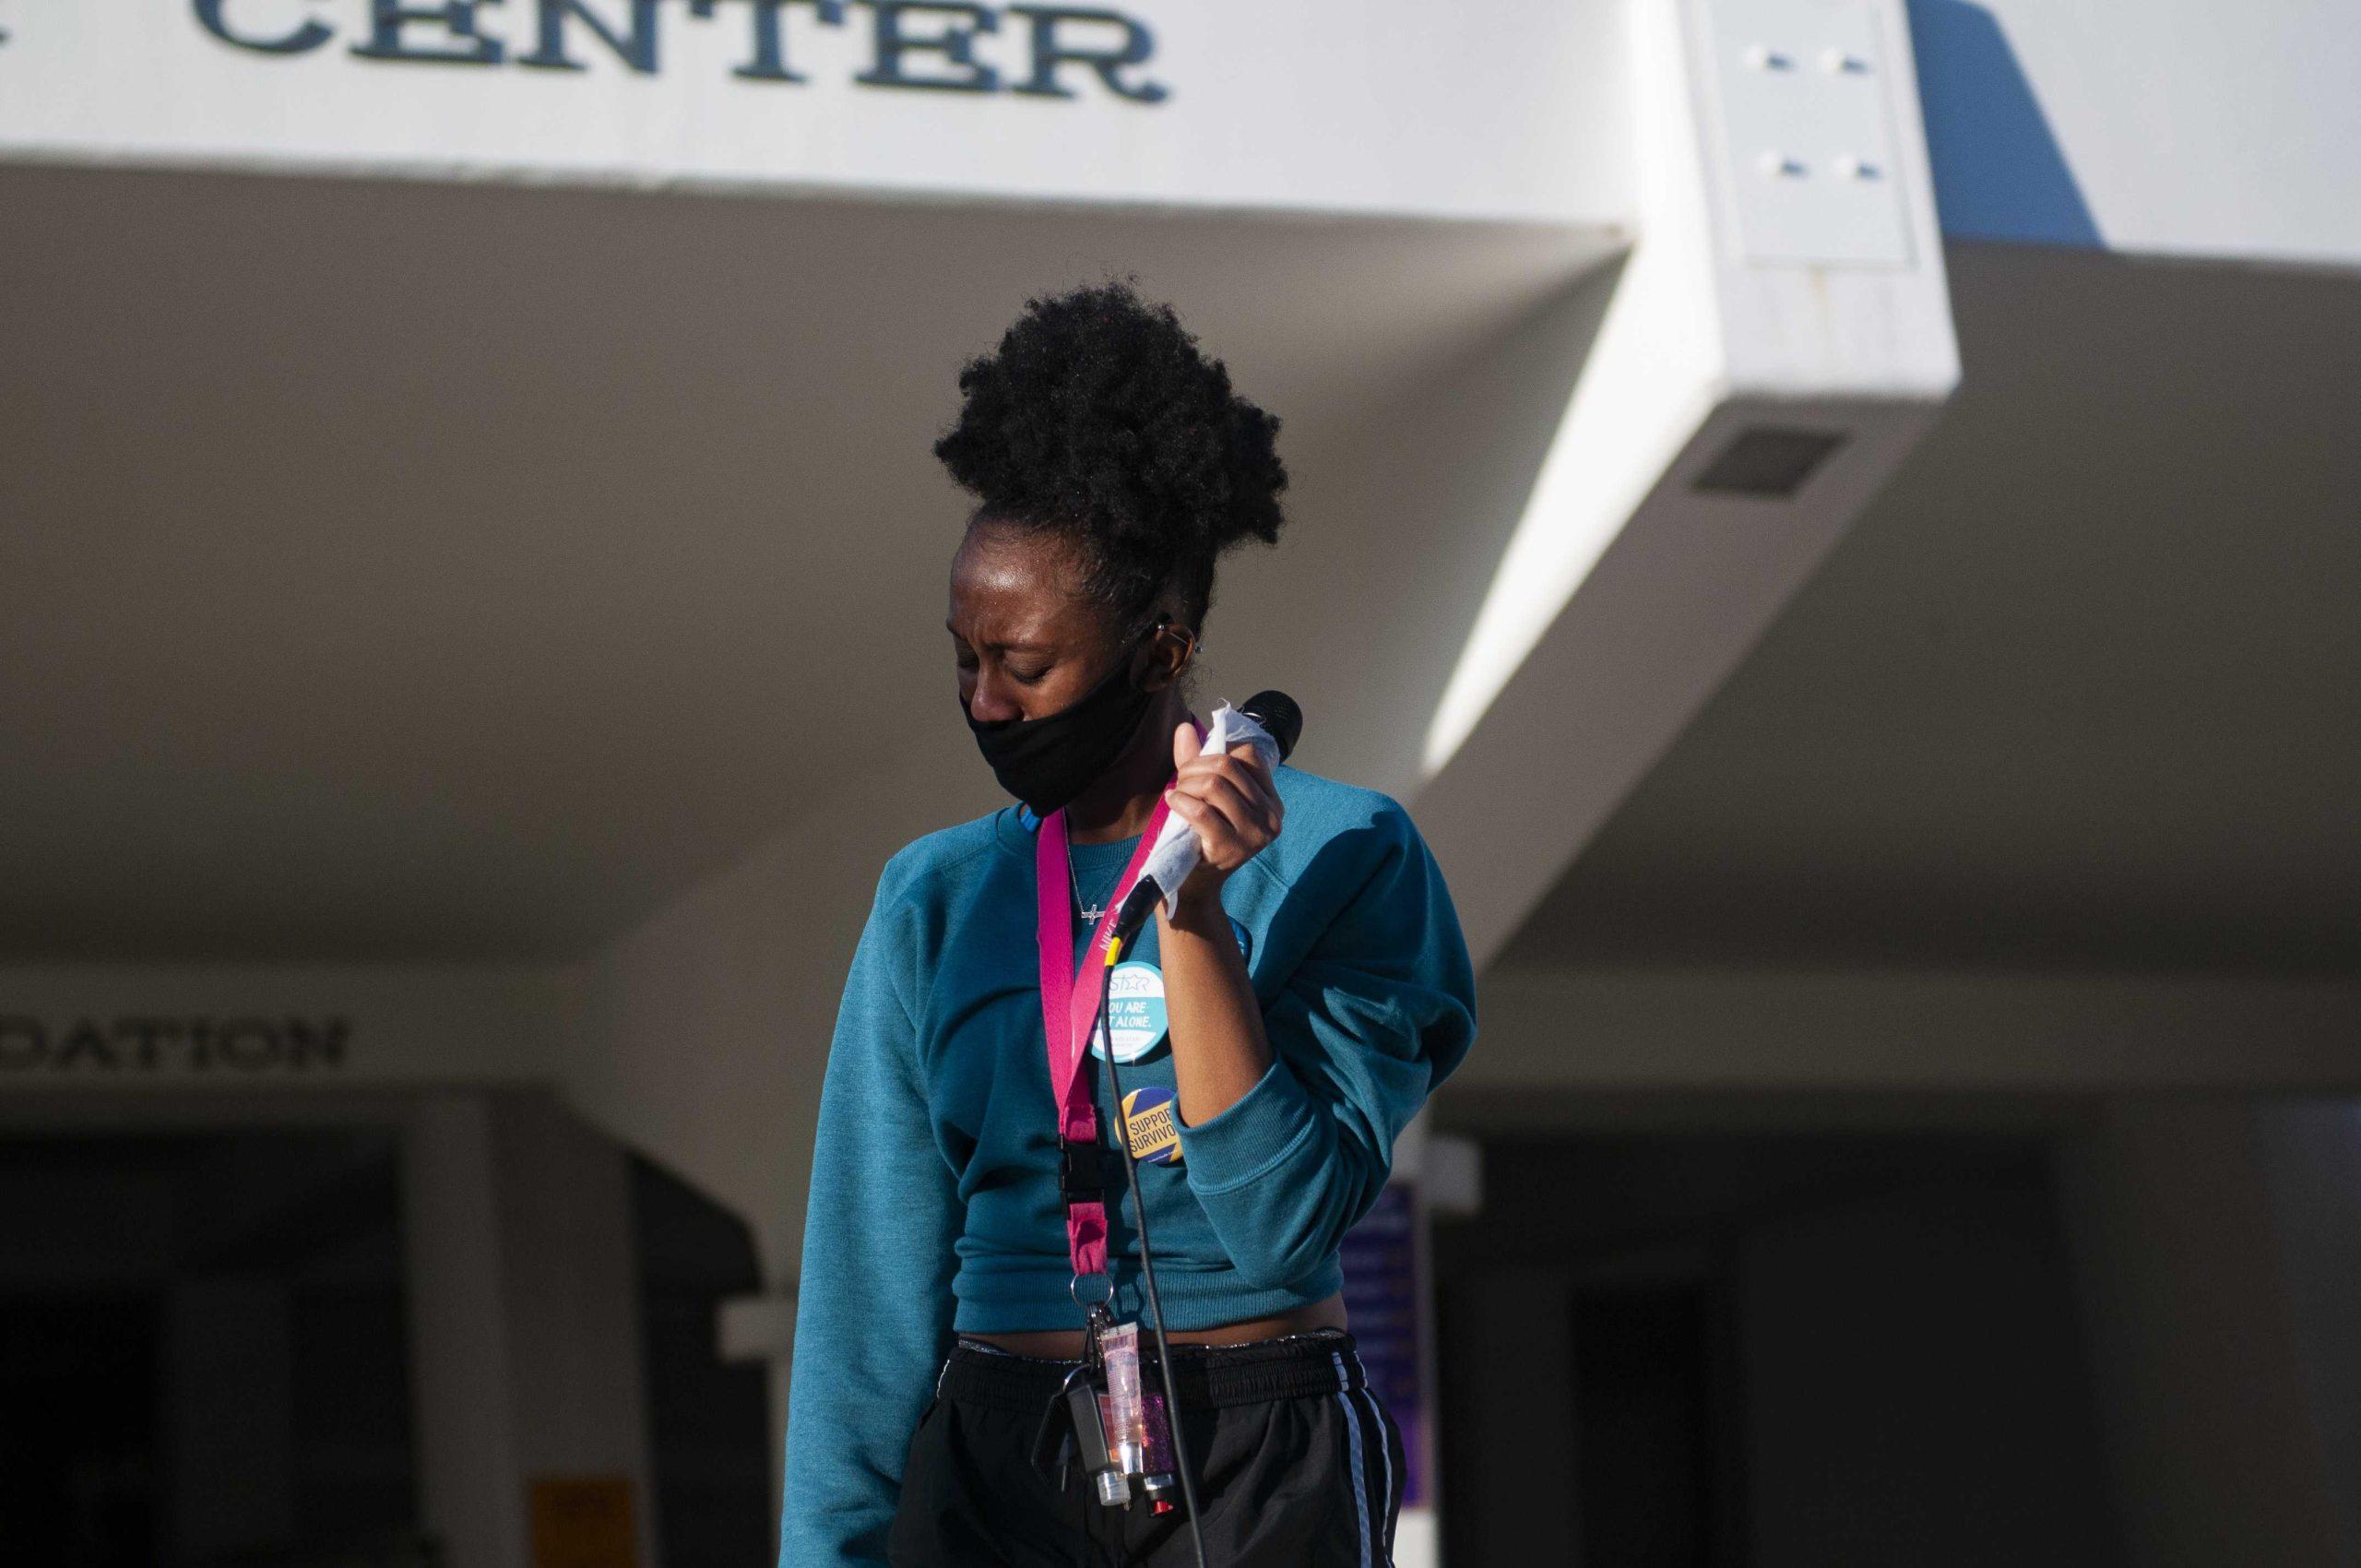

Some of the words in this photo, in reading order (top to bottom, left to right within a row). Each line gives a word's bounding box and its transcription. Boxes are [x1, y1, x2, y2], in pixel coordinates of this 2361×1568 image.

[190, 0, 1171, 103] CENTER
[1109, 1002, 1123, 1014] OU
[1124, 1001, 1147, 1014] ARE
[1115, 1016, 1152, 1028] ALONE.
